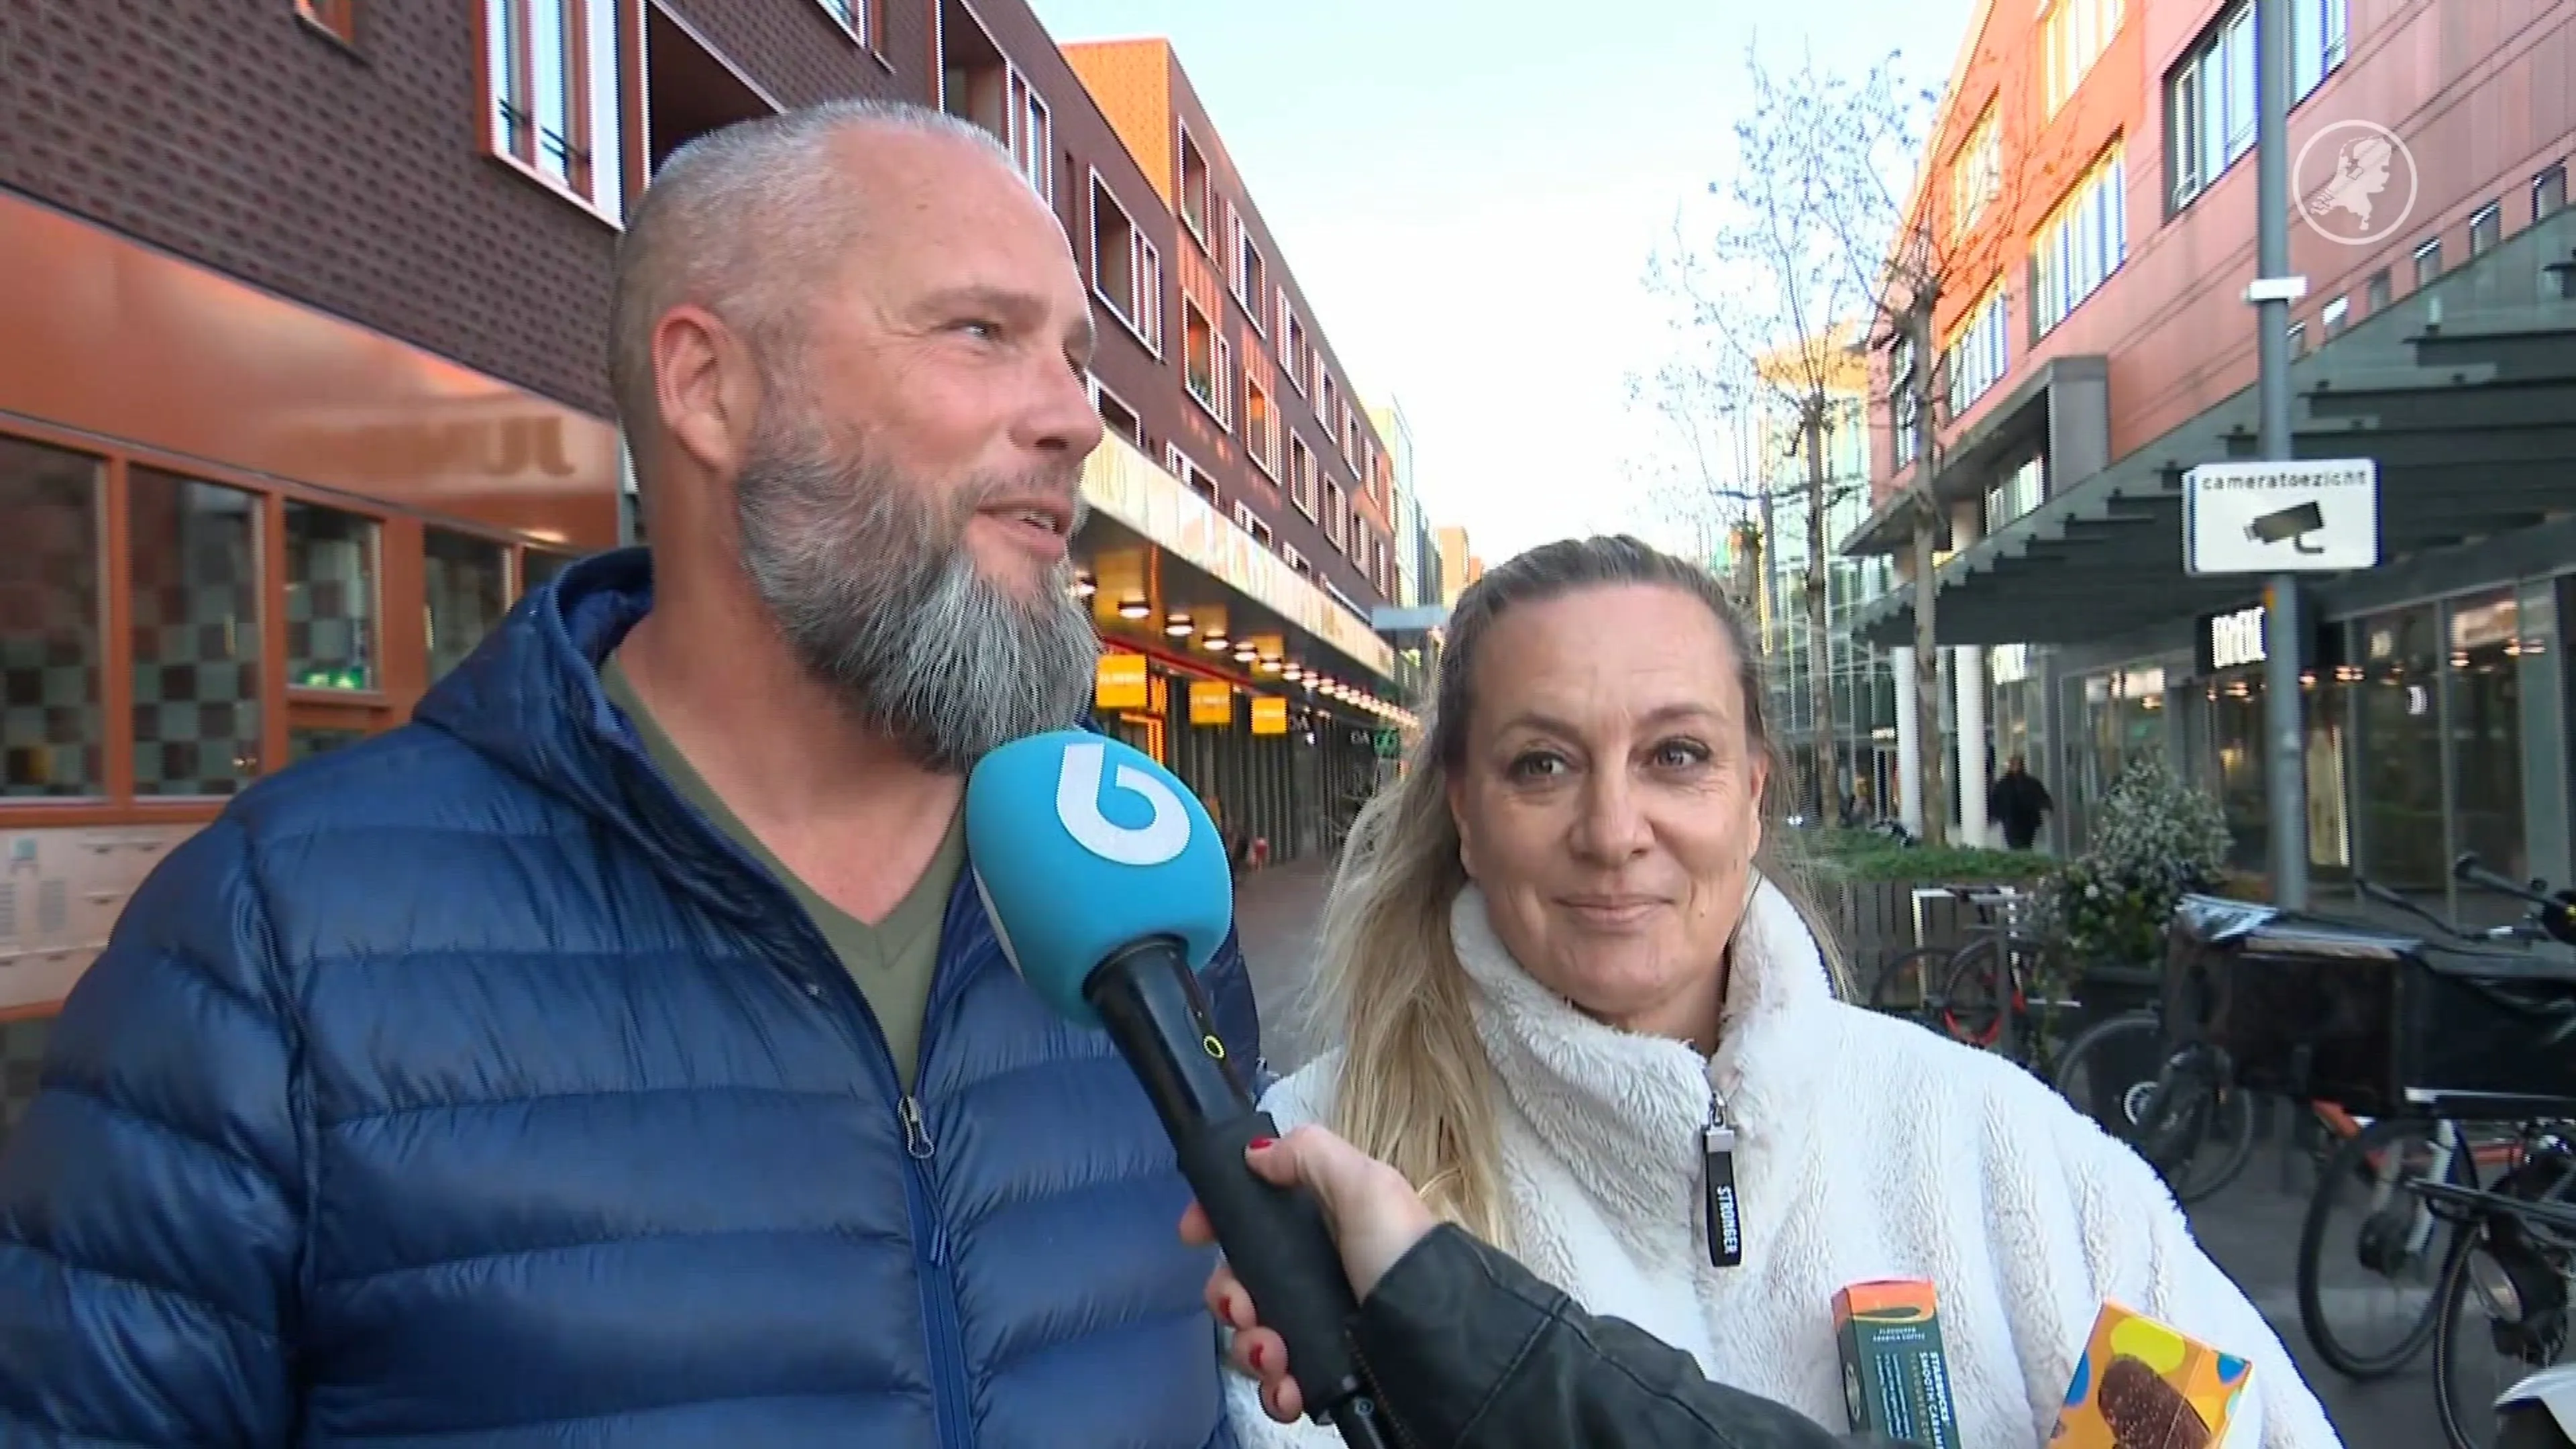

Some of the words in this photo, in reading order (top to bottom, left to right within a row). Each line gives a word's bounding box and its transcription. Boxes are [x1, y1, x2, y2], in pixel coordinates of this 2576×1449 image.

[2201, 471, 2367, 490] cameratoezicht
[1919, 1351, 1935, 1401] SMOOTH
[1928, 1403, 1945, 1449] CARAM
